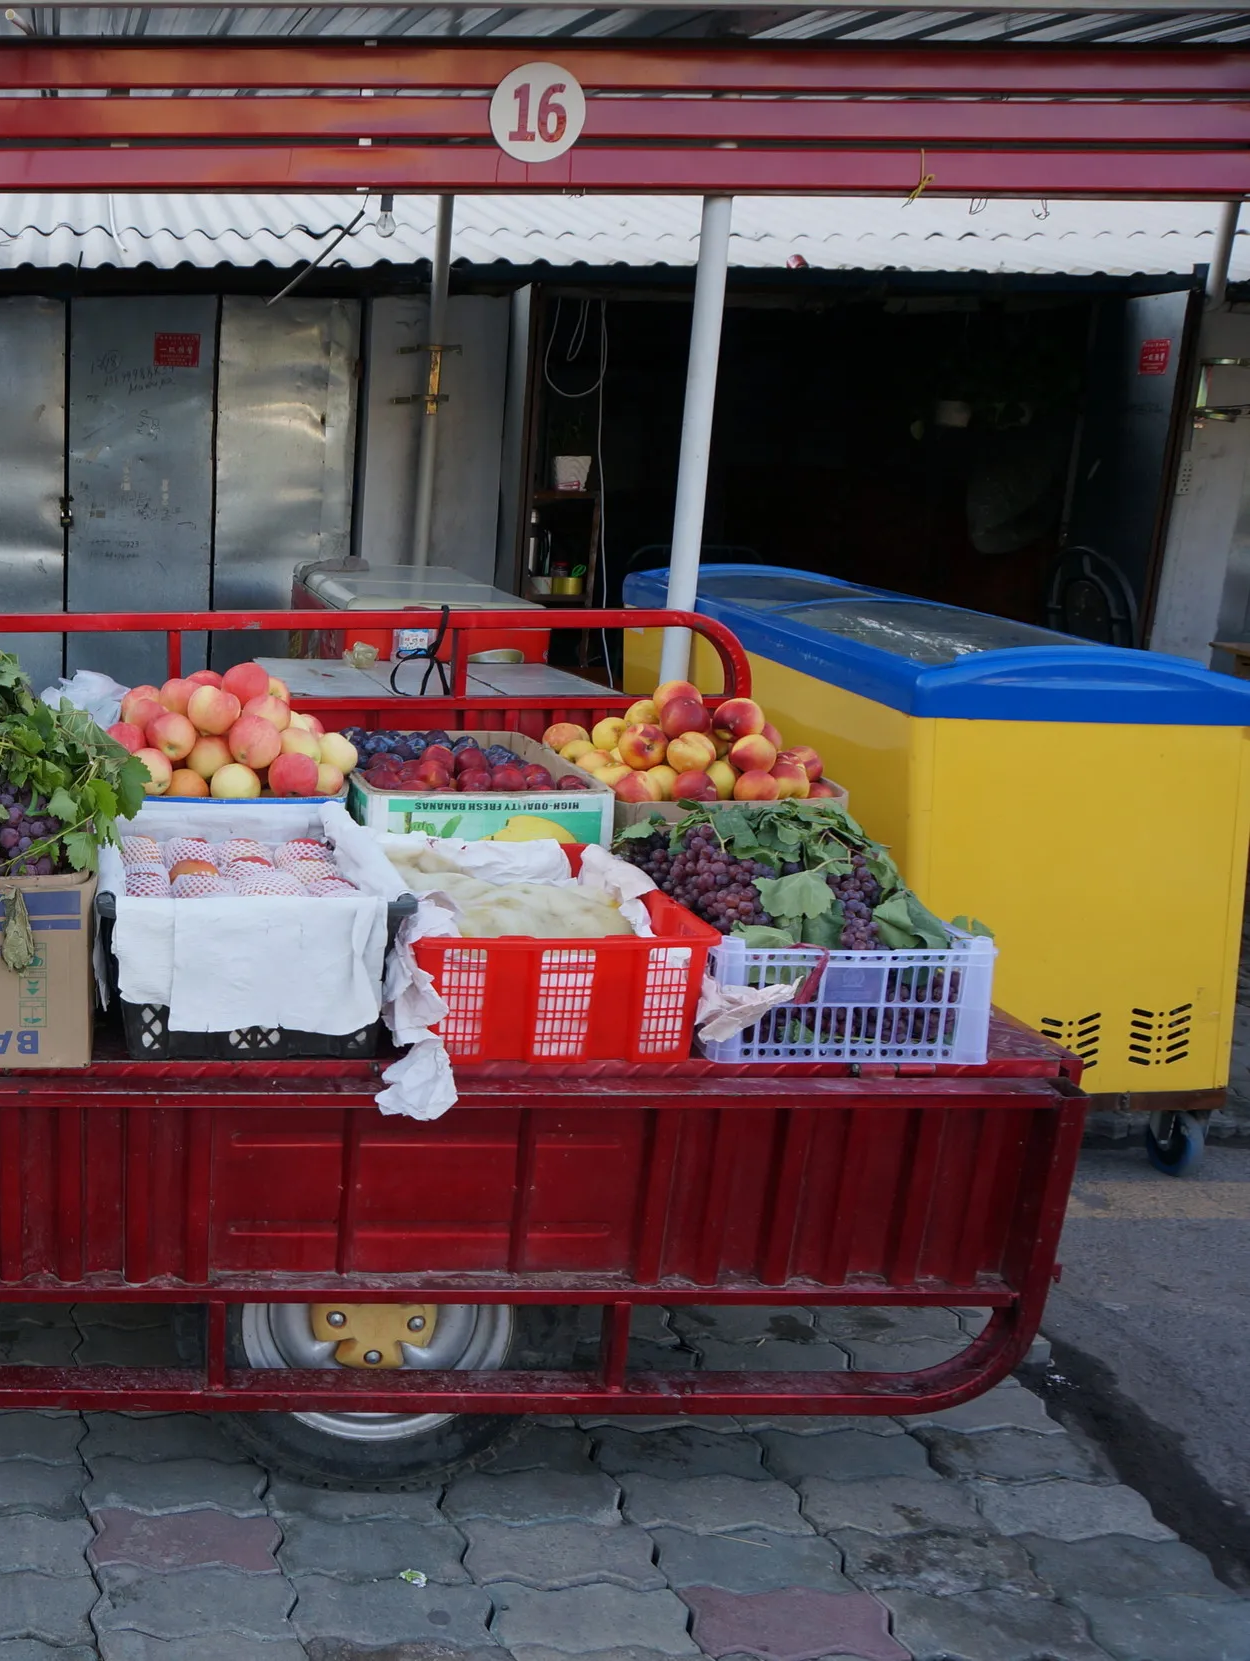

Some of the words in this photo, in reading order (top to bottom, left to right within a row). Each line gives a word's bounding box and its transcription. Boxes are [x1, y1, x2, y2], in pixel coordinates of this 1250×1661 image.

[508, 83, 567, 143] 16
[414, 802, 466, 811] BANANAS
[468, 802, 502, 811] FRESH
